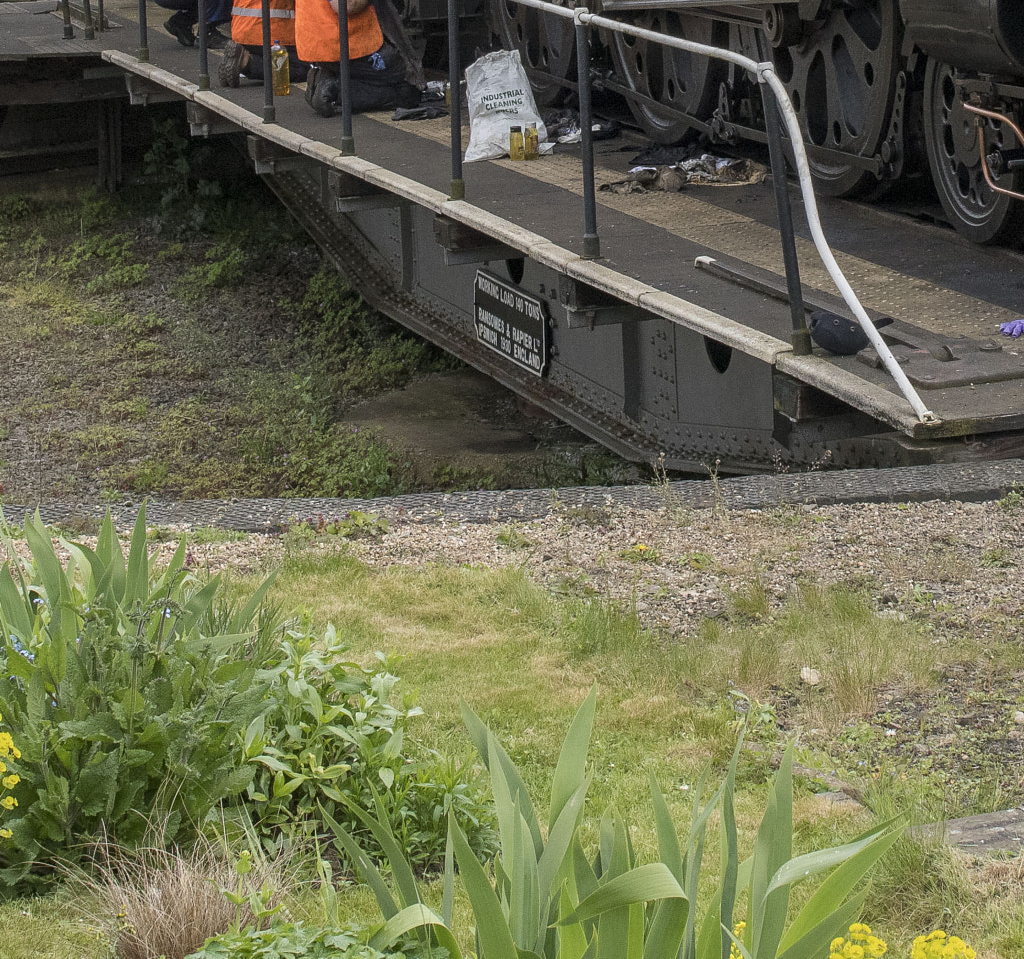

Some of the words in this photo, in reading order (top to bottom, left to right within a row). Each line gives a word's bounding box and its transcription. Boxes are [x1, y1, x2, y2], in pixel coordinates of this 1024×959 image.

[480, 89, 524, 103] INDUSTRIAL
[485, 97, 523, 111] CLEANING
[478, 275, 499, 300] WORKING
[500, 288, 514, 308] LOAD
[525, 301, 539, 321] TONS
[512, 327, 532, 349] RAPIER
[513, 344, 540, 370] ENGLAND
